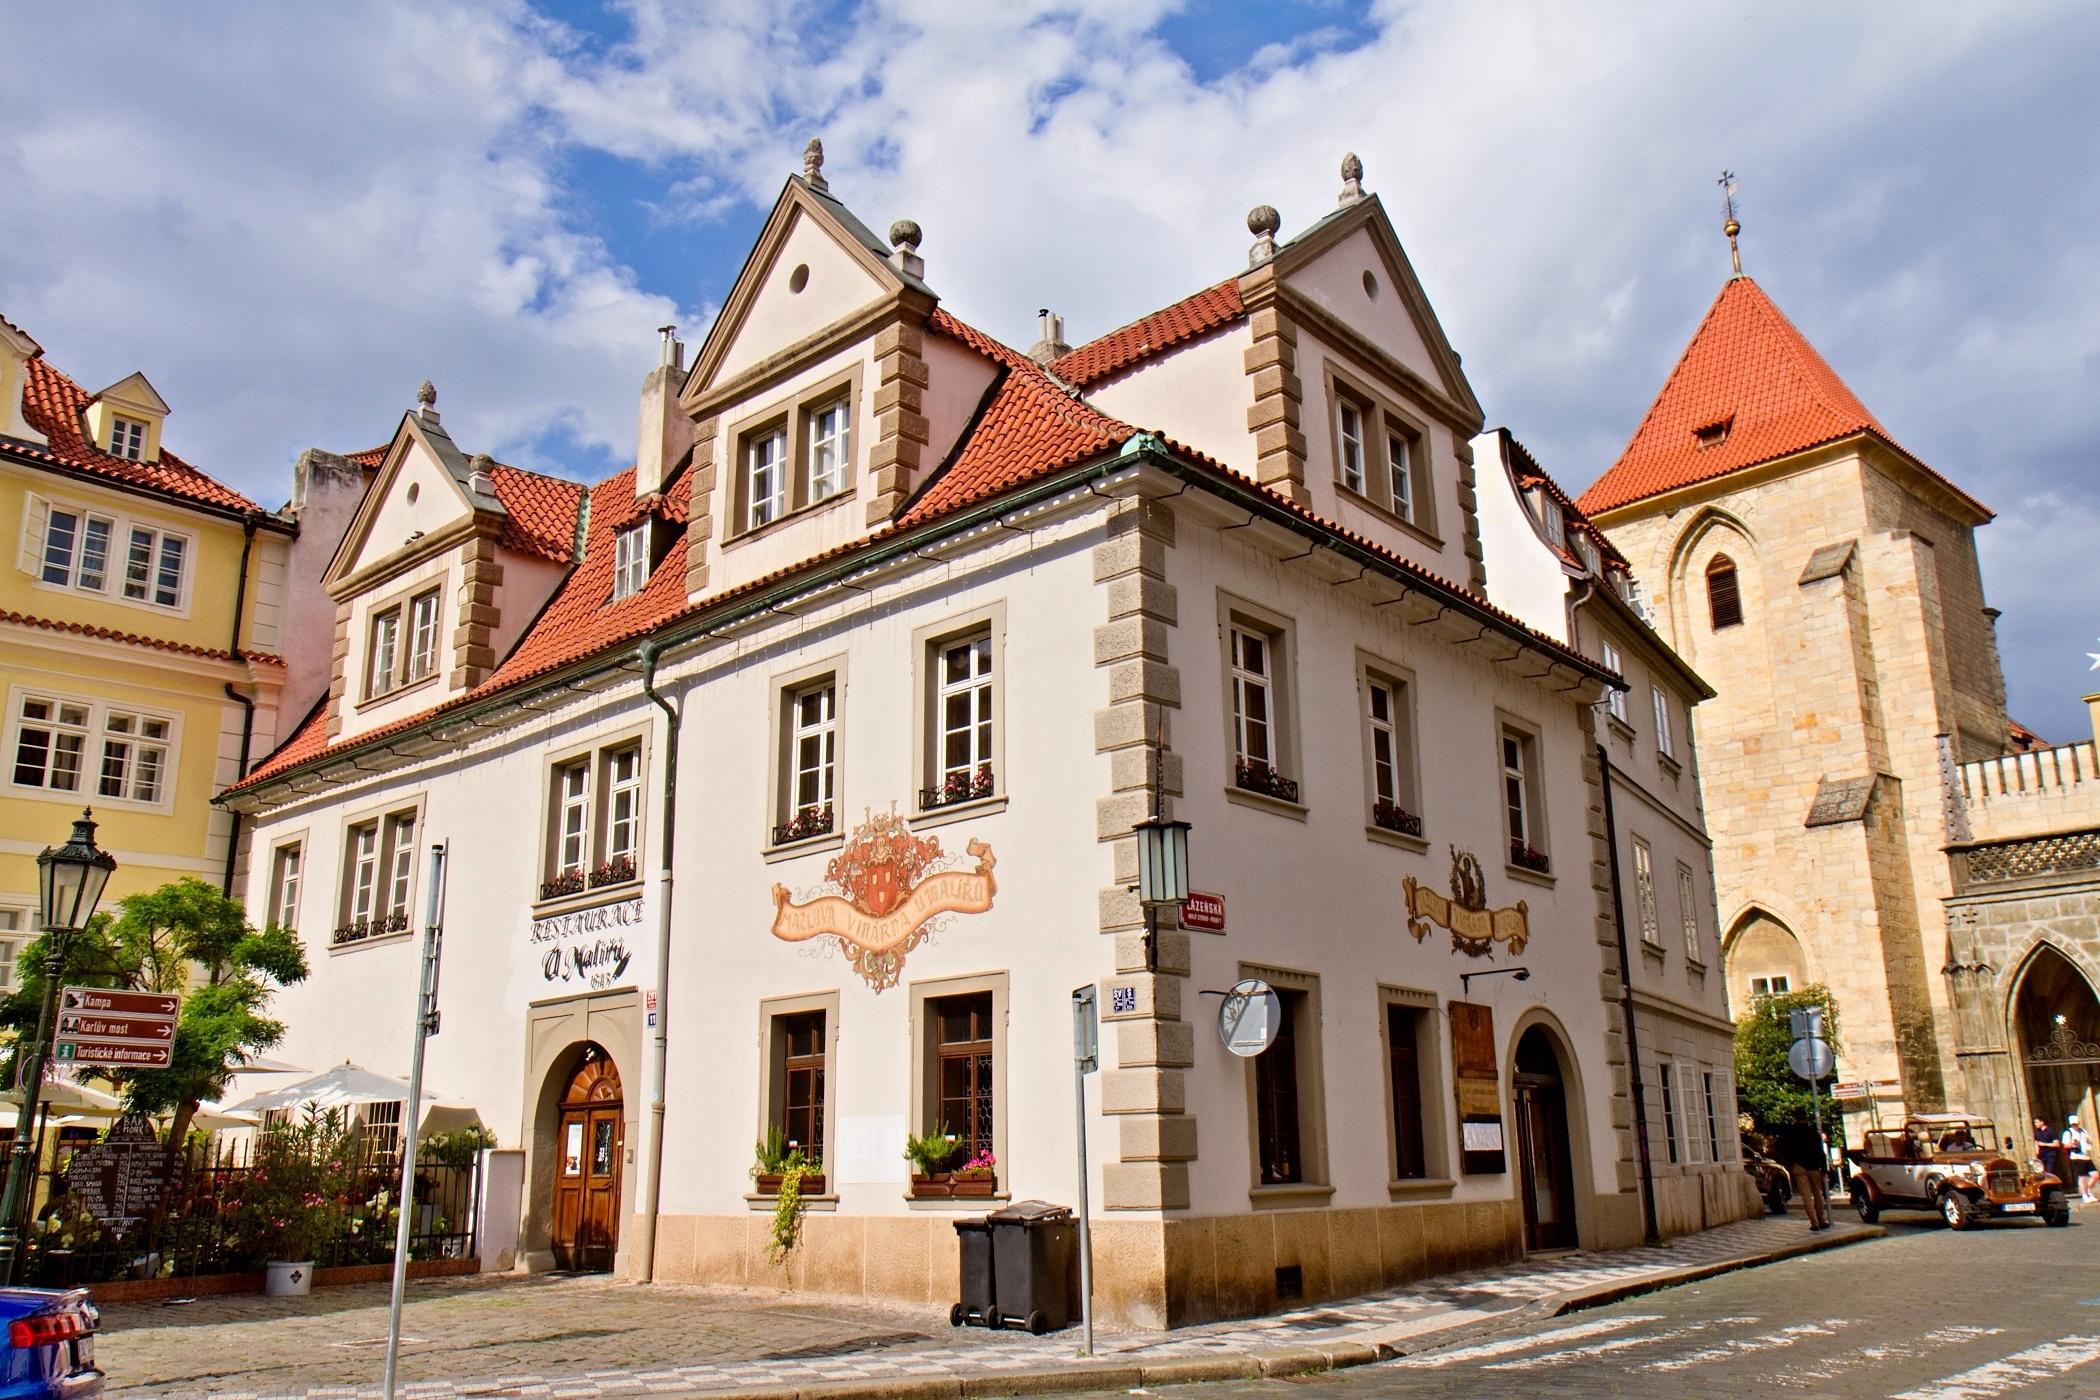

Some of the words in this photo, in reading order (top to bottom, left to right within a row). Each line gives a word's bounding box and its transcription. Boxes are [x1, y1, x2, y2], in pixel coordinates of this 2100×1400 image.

[84, 994, 112, 1010] Kampa
[649, 1014, 656, 1025] 11
[80, 1020, 107, 1033] Karlův
[108, 1023, 129, 1035] most
[76, 1045, 113, 1060] Turistické
[113, 1047, 152, 1061] informace
